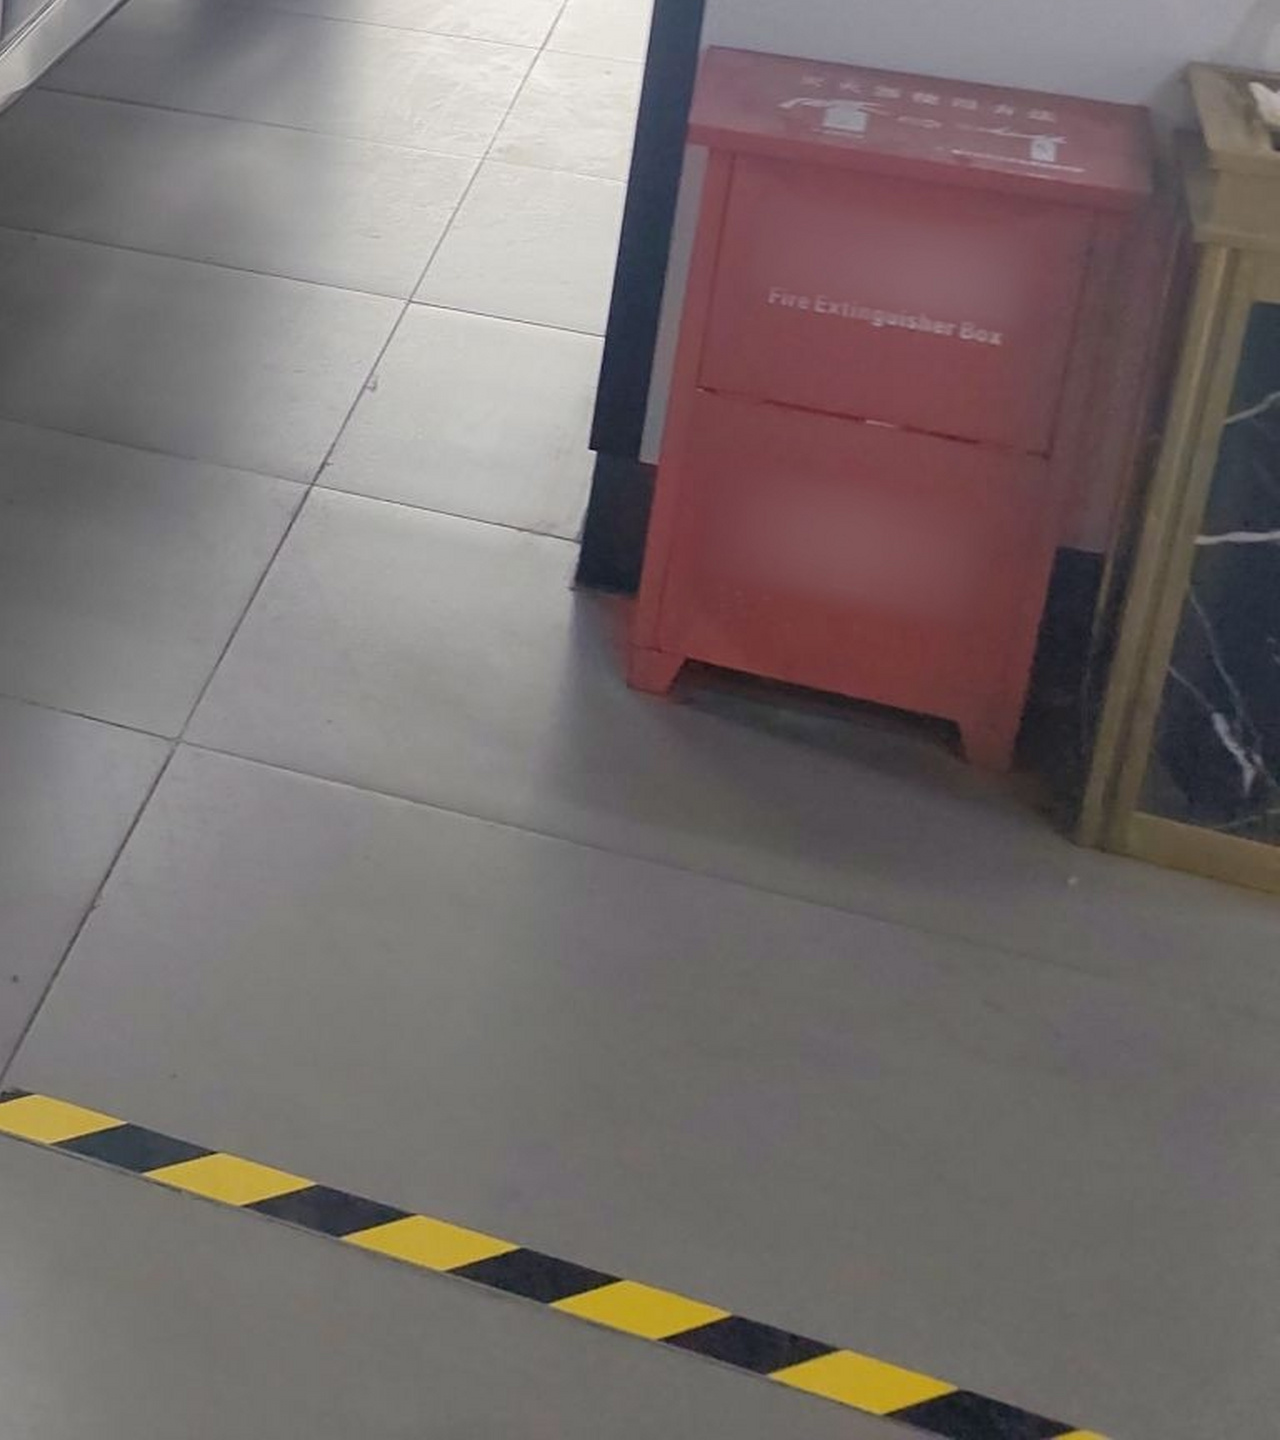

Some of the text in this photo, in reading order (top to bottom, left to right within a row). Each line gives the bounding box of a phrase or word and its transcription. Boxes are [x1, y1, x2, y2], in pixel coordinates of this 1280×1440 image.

[767, 286, 1004, 346] Fire Extinguisher Box
